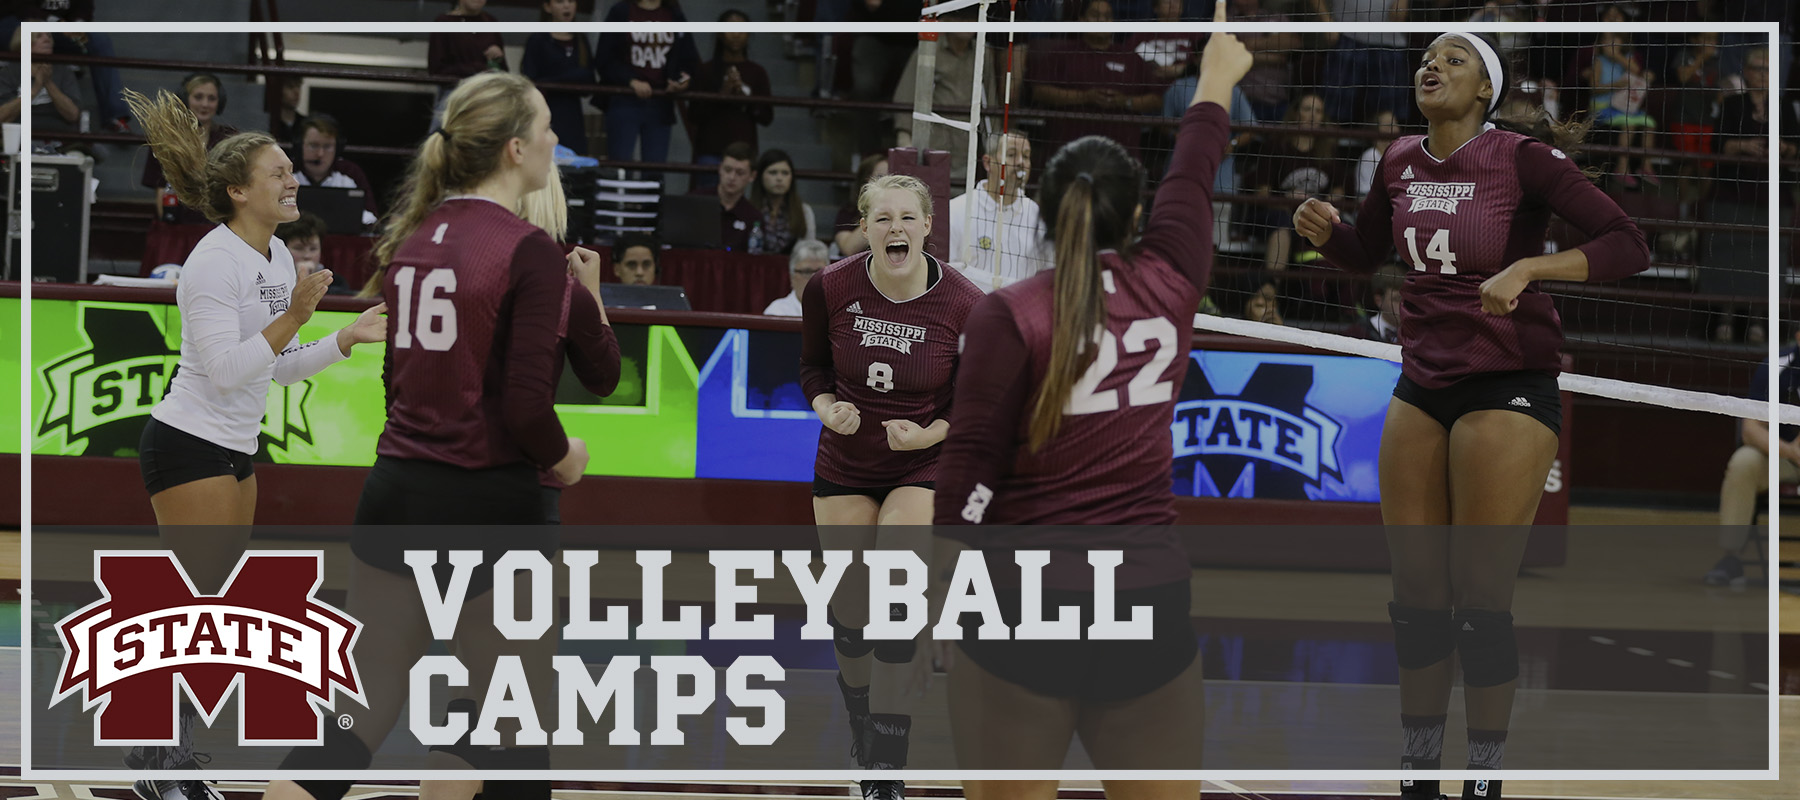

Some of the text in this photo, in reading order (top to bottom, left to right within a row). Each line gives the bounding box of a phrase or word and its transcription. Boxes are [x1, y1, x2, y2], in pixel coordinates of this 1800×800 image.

[1406, 184, 1475, 198] MISSISSIPPI
[1417, 199, 1450, 211] STATE
[1403, 226, 1457, 275] 14
[393, 266, 457, 351] 16
[852, 317, 927, 341] MISSISSIPPI
[869, 336, 903, 350] STATE
[866, 361, 894, 393] 8
[1062, 316, 1178, 415] 22
[1175, 407, 1303, 466] TATE
